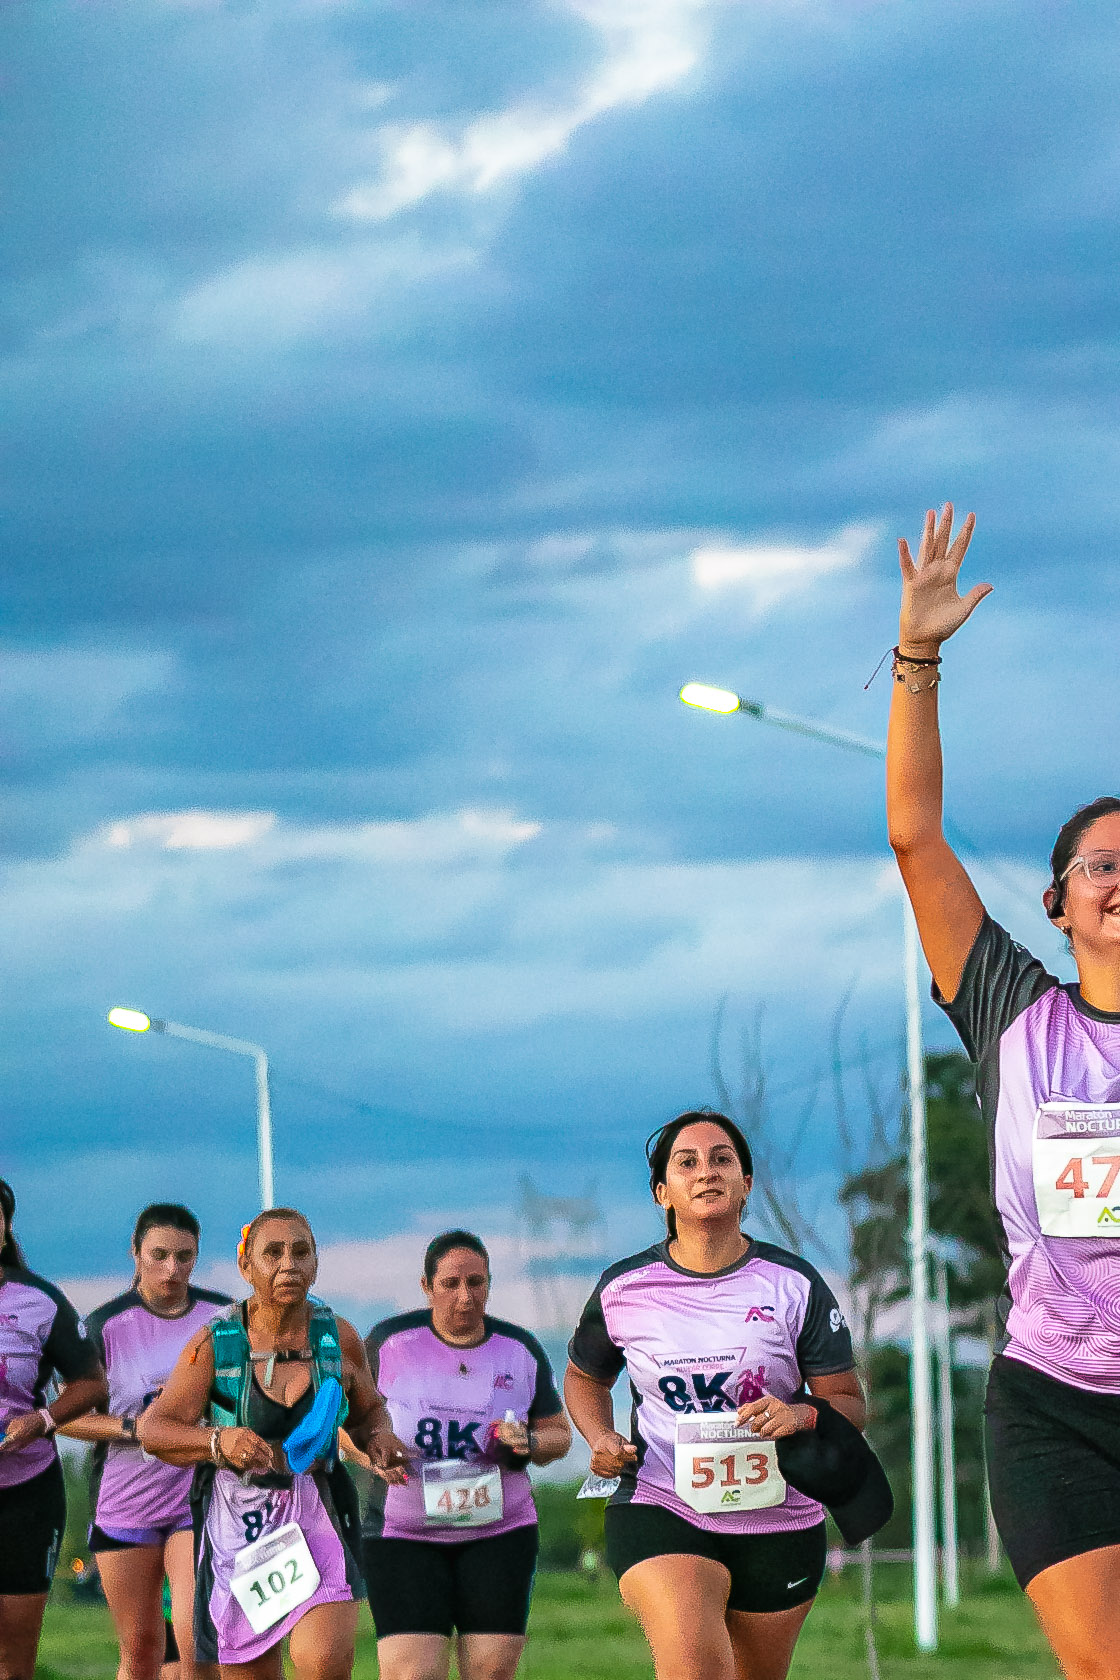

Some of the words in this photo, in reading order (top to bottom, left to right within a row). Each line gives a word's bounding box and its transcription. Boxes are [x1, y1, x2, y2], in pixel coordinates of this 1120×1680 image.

[698, 1354, 736, 1364] NOCTURNA
[658, 1371, 738, 1412] 8K
[415, 1417, 483, 1456] 8K
[692, 1453, 769, 1488] 513
[437, 1485, 491, 1513] 428
[249, 1558, 304, 1607] 102
